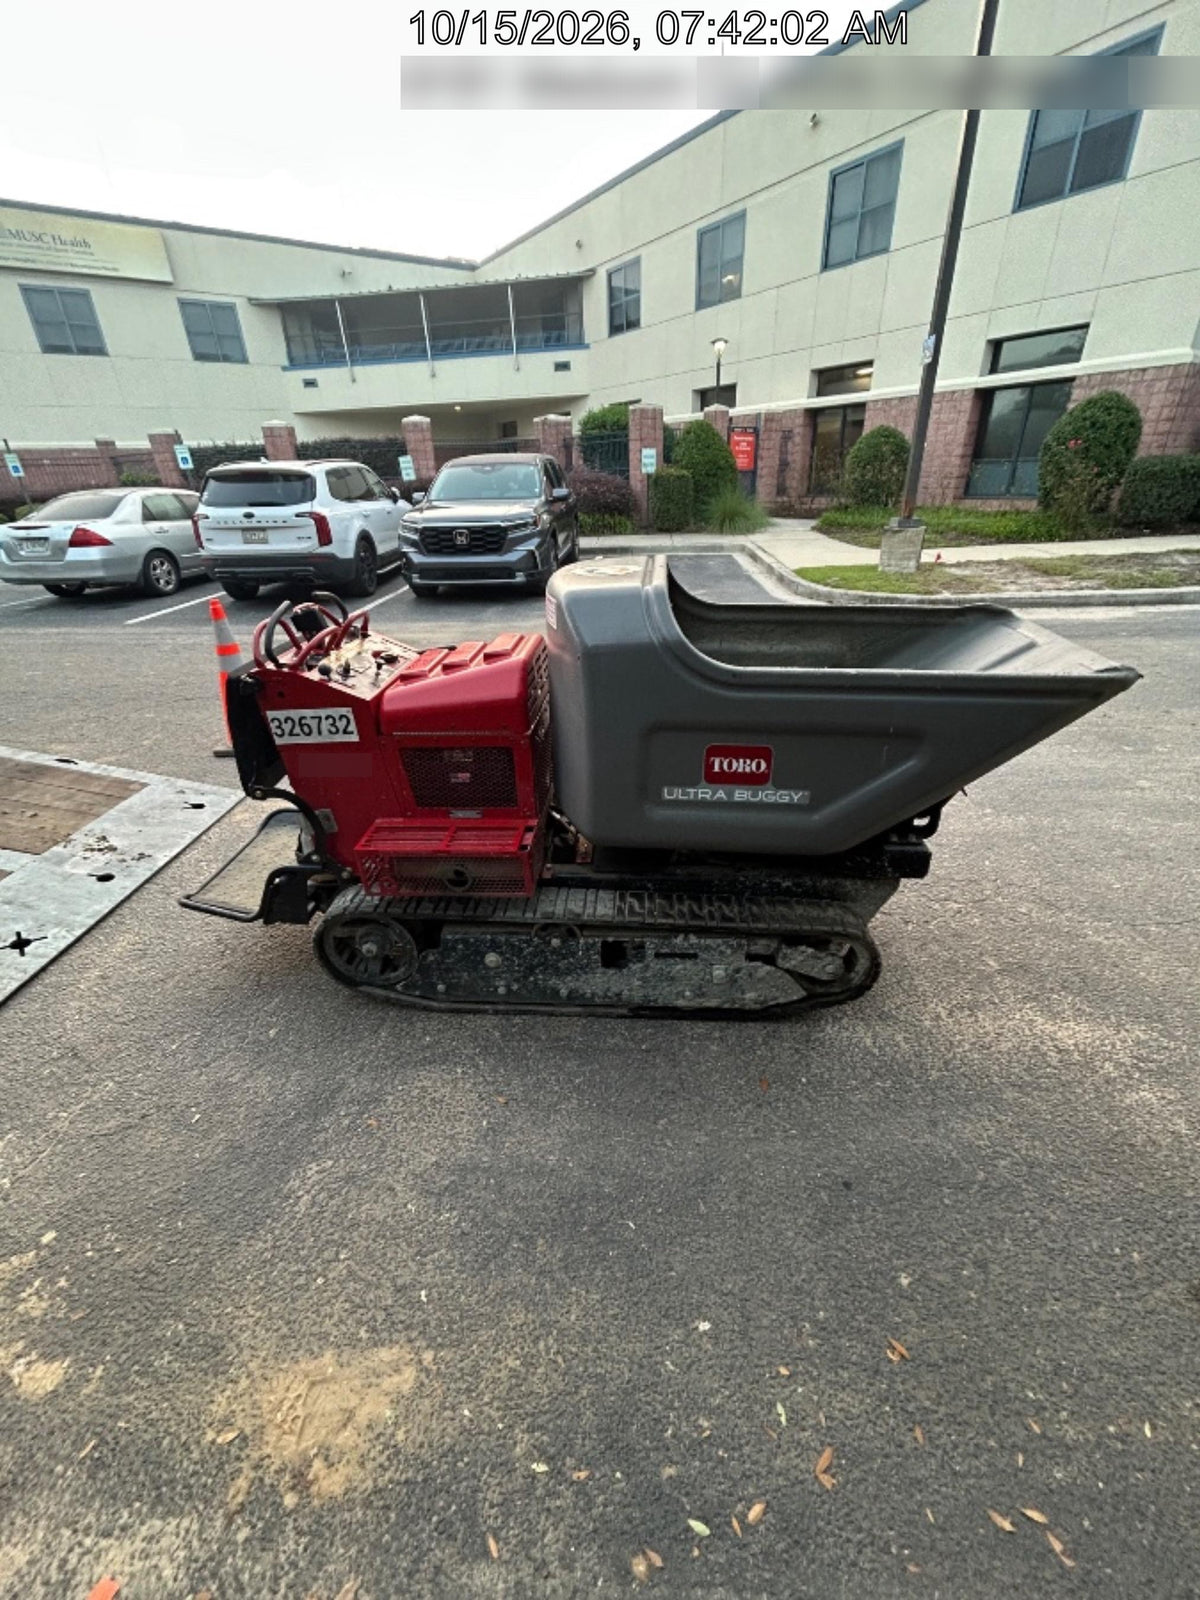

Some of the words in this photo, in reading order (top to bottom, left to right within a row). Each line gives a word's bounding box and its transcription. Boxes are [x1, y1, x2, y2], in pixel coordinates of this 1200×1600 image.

[7, 228, 49, 244] MUSC
[50, 233, 92, 249] Health
[269, 713, 355, 738] 326732
[709, 757, 767, 773] TORO
[664, 787, 728, 801] ULTRA
[734, 789, 803, 803] BUGGY
